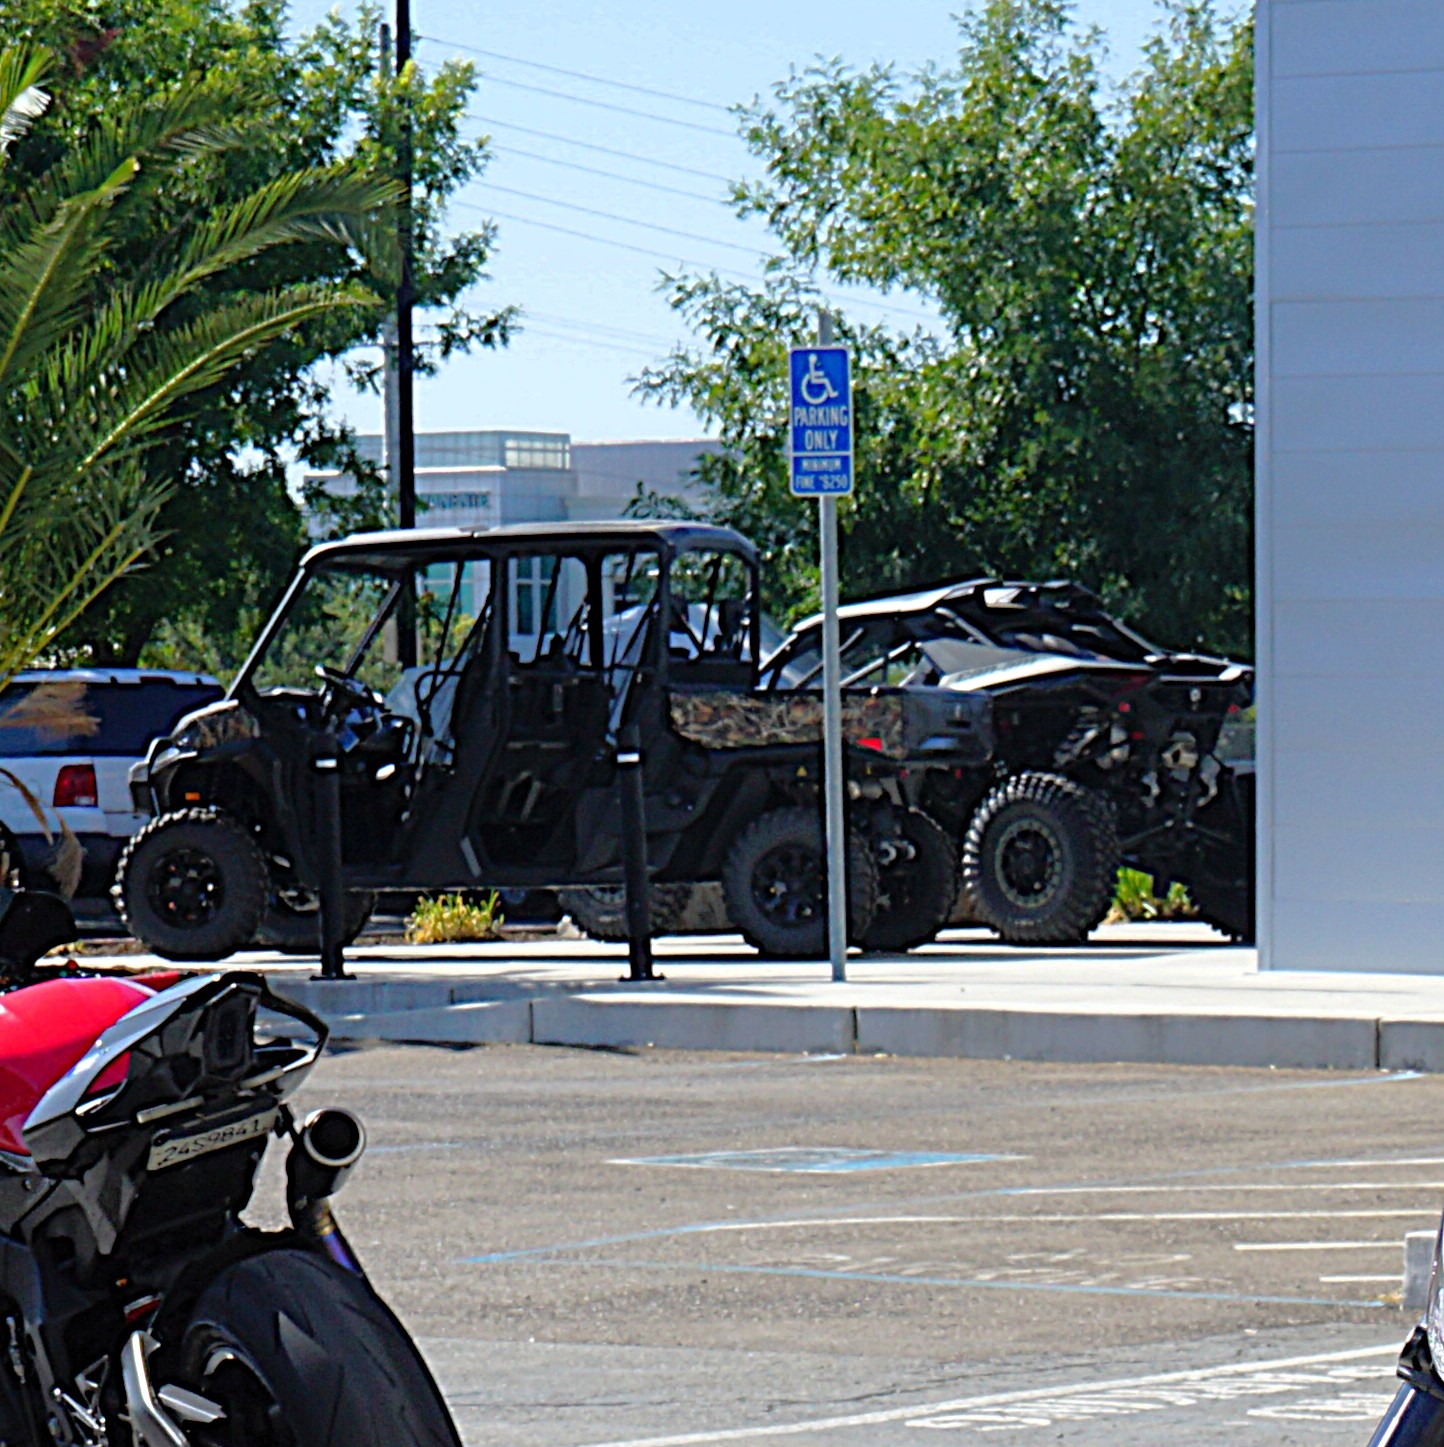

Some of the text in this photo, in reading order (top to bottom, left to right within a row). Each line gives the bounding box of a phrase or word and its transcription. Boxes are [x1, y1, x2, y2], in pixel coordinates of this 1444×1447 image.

[794, 406, 849, 427] PARKING
[804, 430, 839, 451] ONLY
[802, 458, 842, 472] MINIMUM
[795, 473, 849, 490] FINE $250
